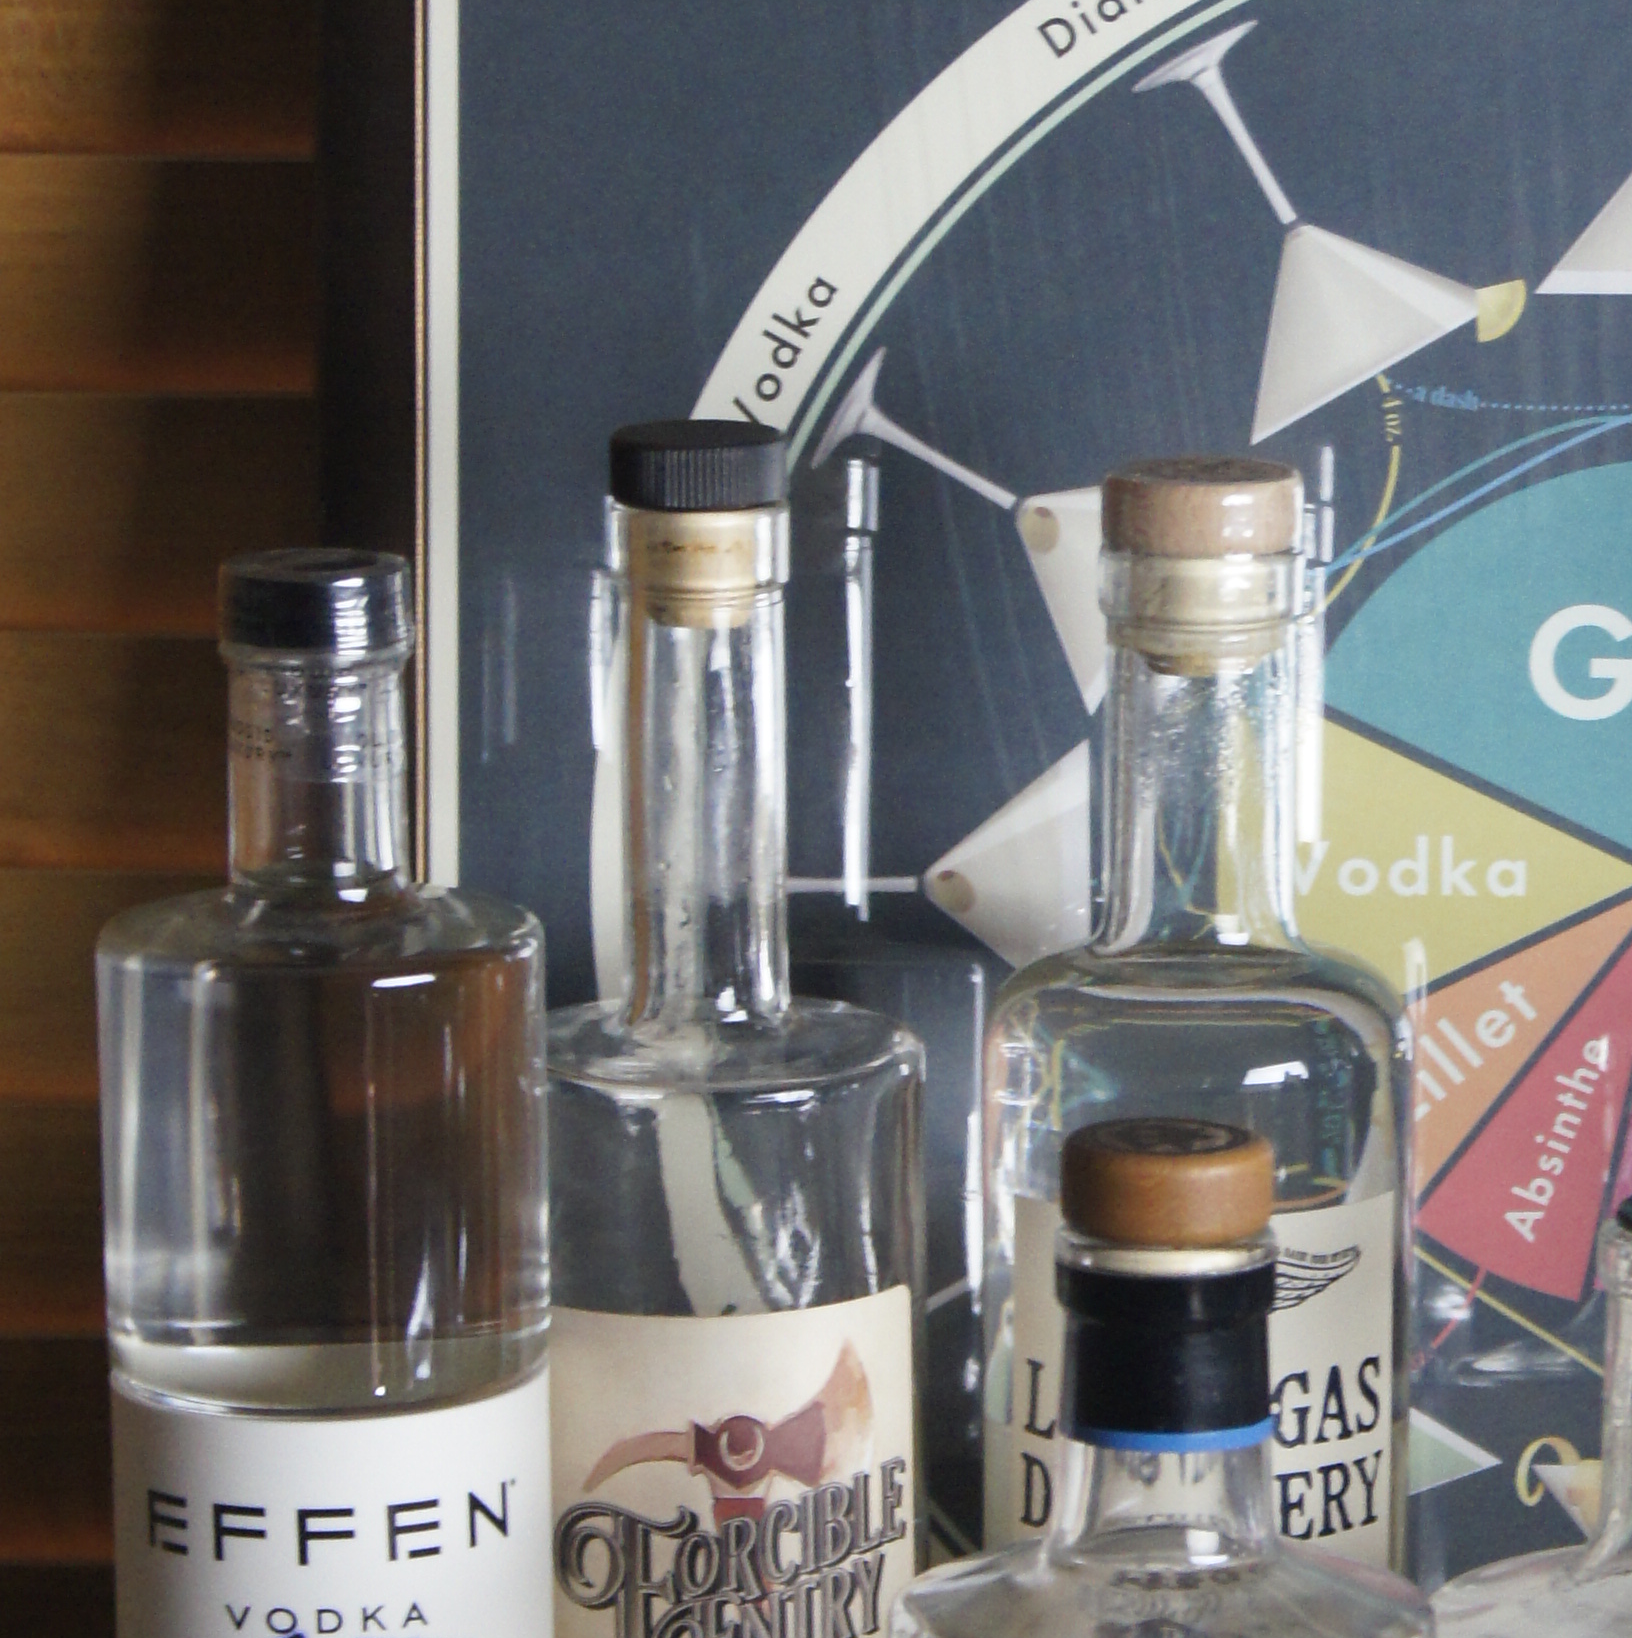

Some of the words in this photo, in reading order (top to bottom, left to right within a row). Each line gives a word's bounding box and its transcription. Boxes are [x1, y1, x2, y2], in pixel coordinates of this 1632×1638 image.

[1504, 1033, 1611, 1243] Absinthe
[146, 1479, 510, 1566] EFFEN
[225, 1602, 429, 1635] VODKA
